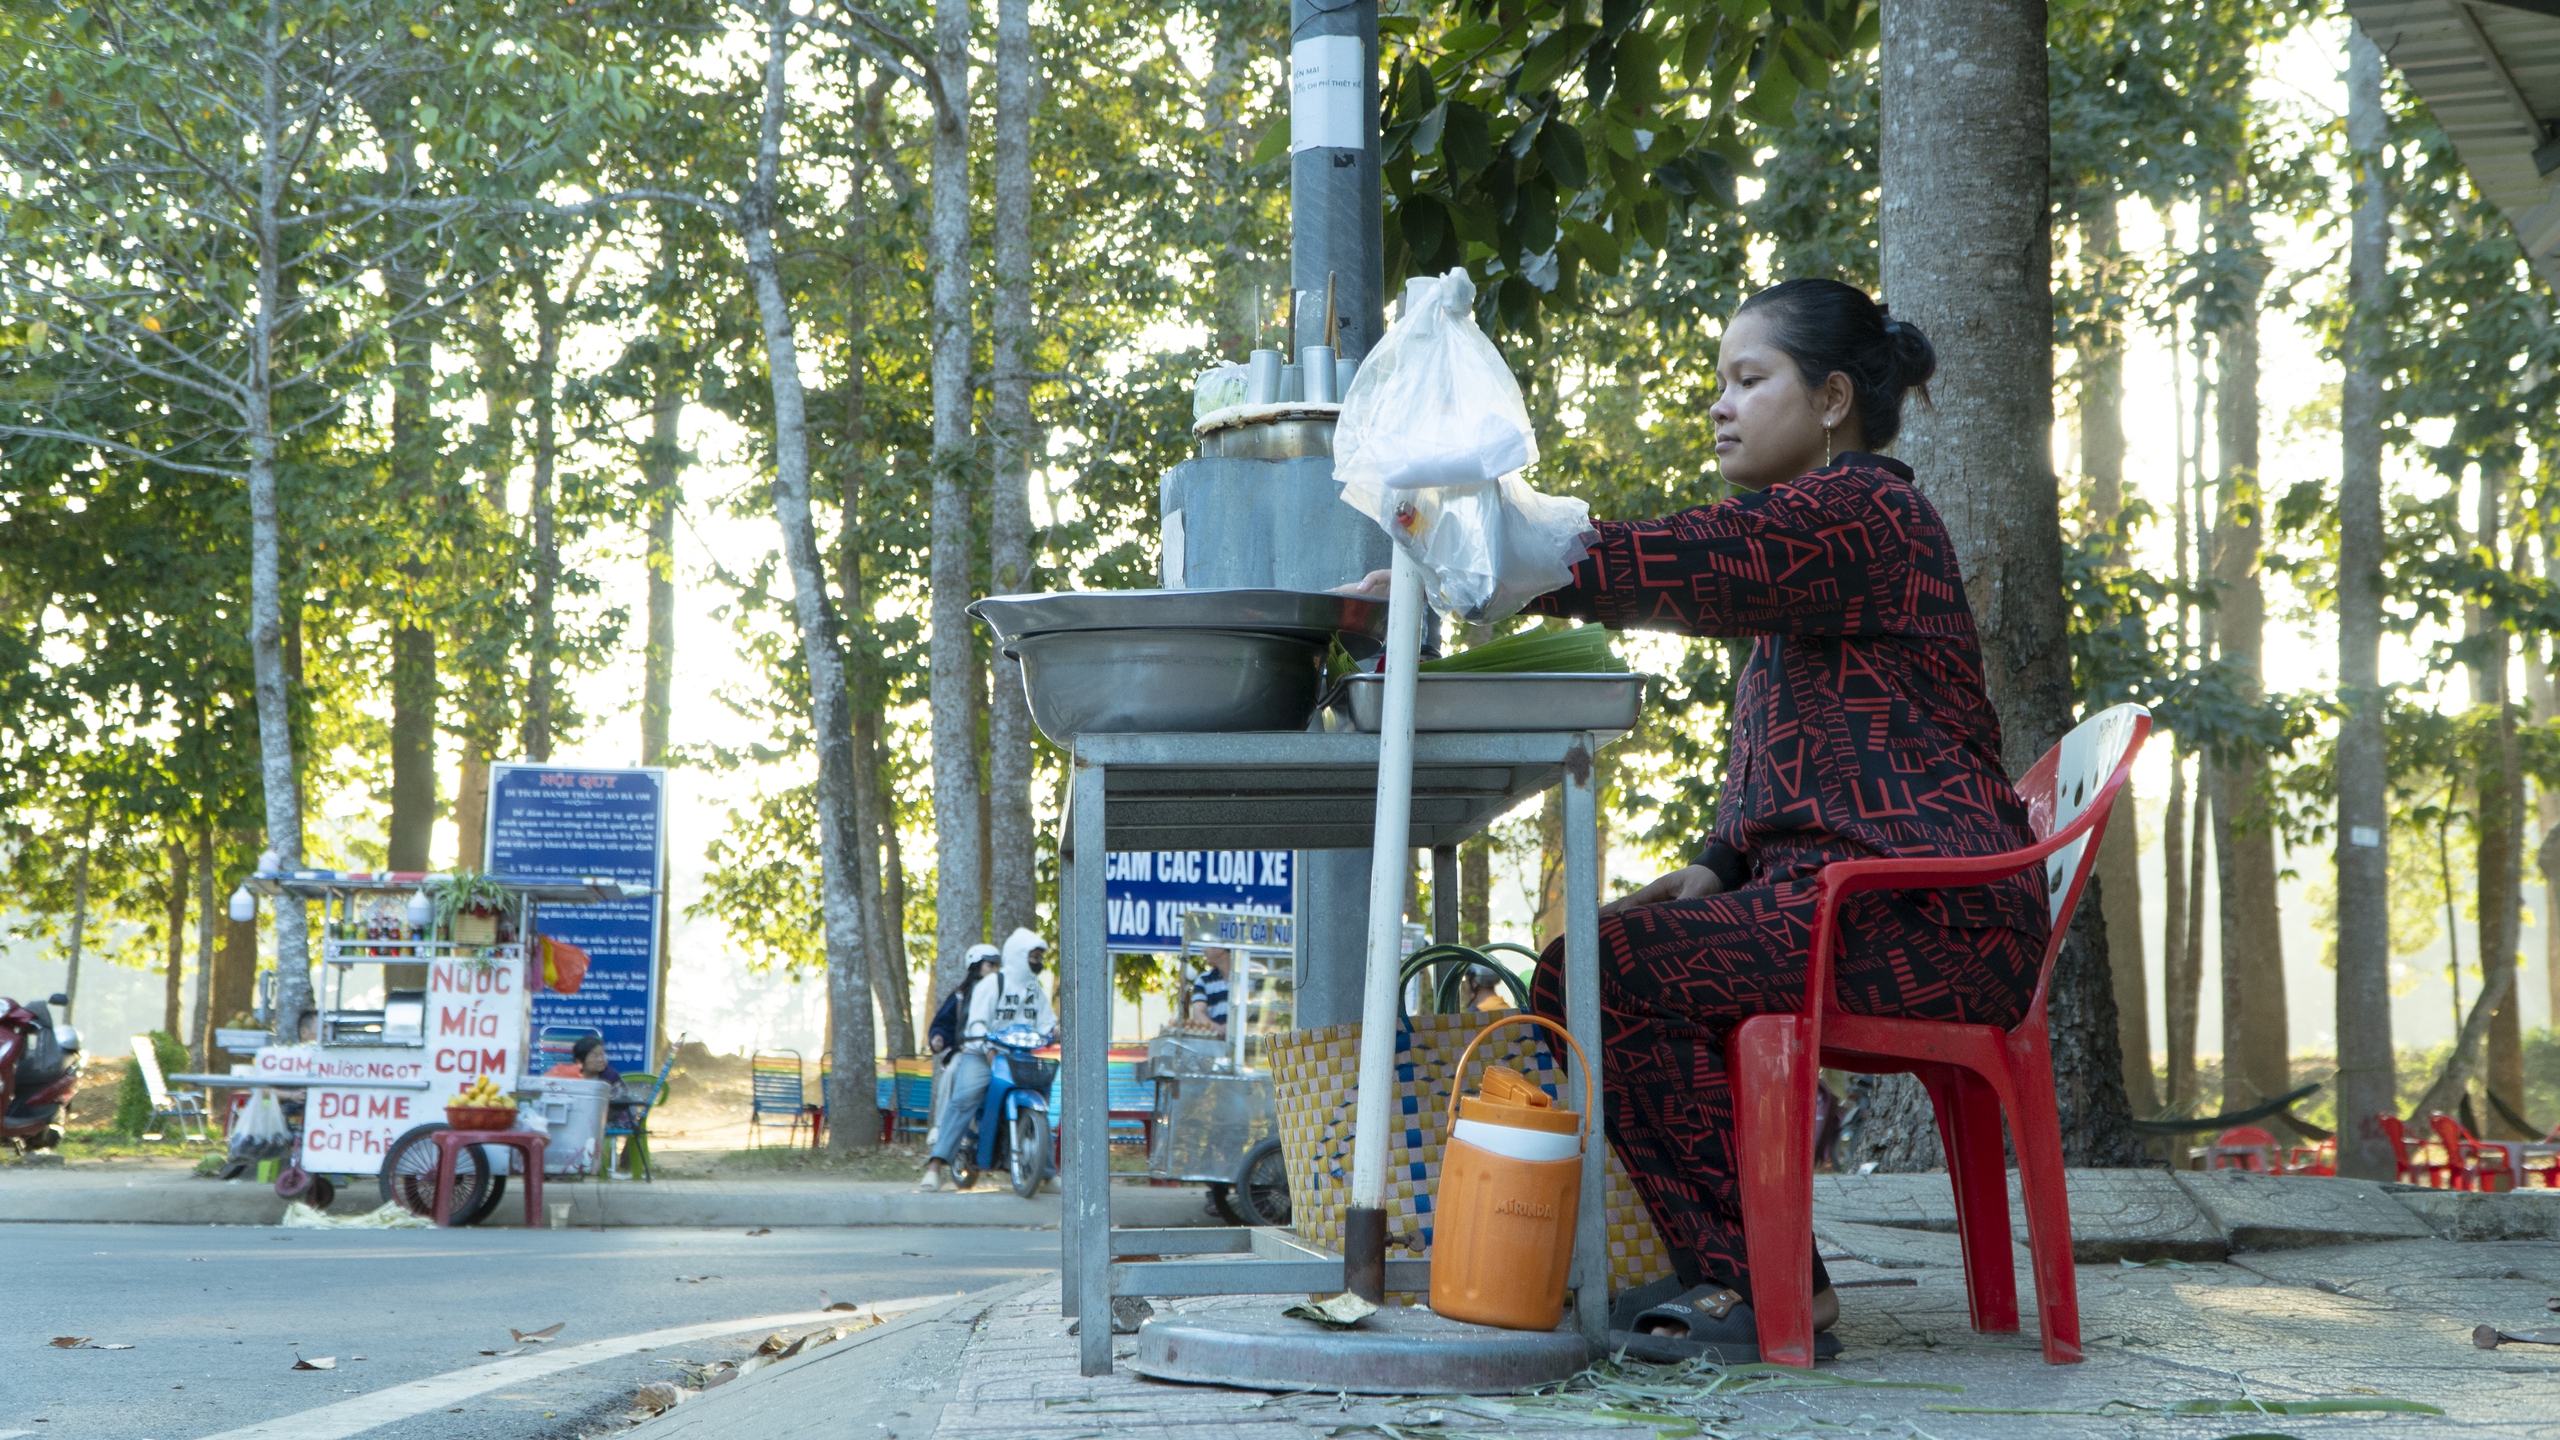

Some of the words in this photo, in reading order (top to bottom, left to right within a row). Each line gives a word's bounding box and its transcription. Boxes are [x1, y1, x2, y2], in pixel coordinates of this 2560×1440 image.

[1671, 513, 1752, 541] ARTHUR
[1602, 522, 1640, 614] EMINEM
[1911, 612, 1978, 634] ARTHUR
[1782, 647, 1824, 725] ARTHUR
[1819, 697, 1862, 779] ARTHUR
[539, 772, 575, 788] NỘI
[579, 774, 617, 790] QUY
[1855, 821, 1958, 843] EMINEM
[1206, 851, 1255, 893] LOẠI
[1259, 851, 1288, 887] XE
[1107, 892, 1150, 936] VÀO
[1155, 901, 1200, 938] KH
[1636, 939, 1690, 962] EMINEM
[1705, 929, 1752, 948] ARTHUR
